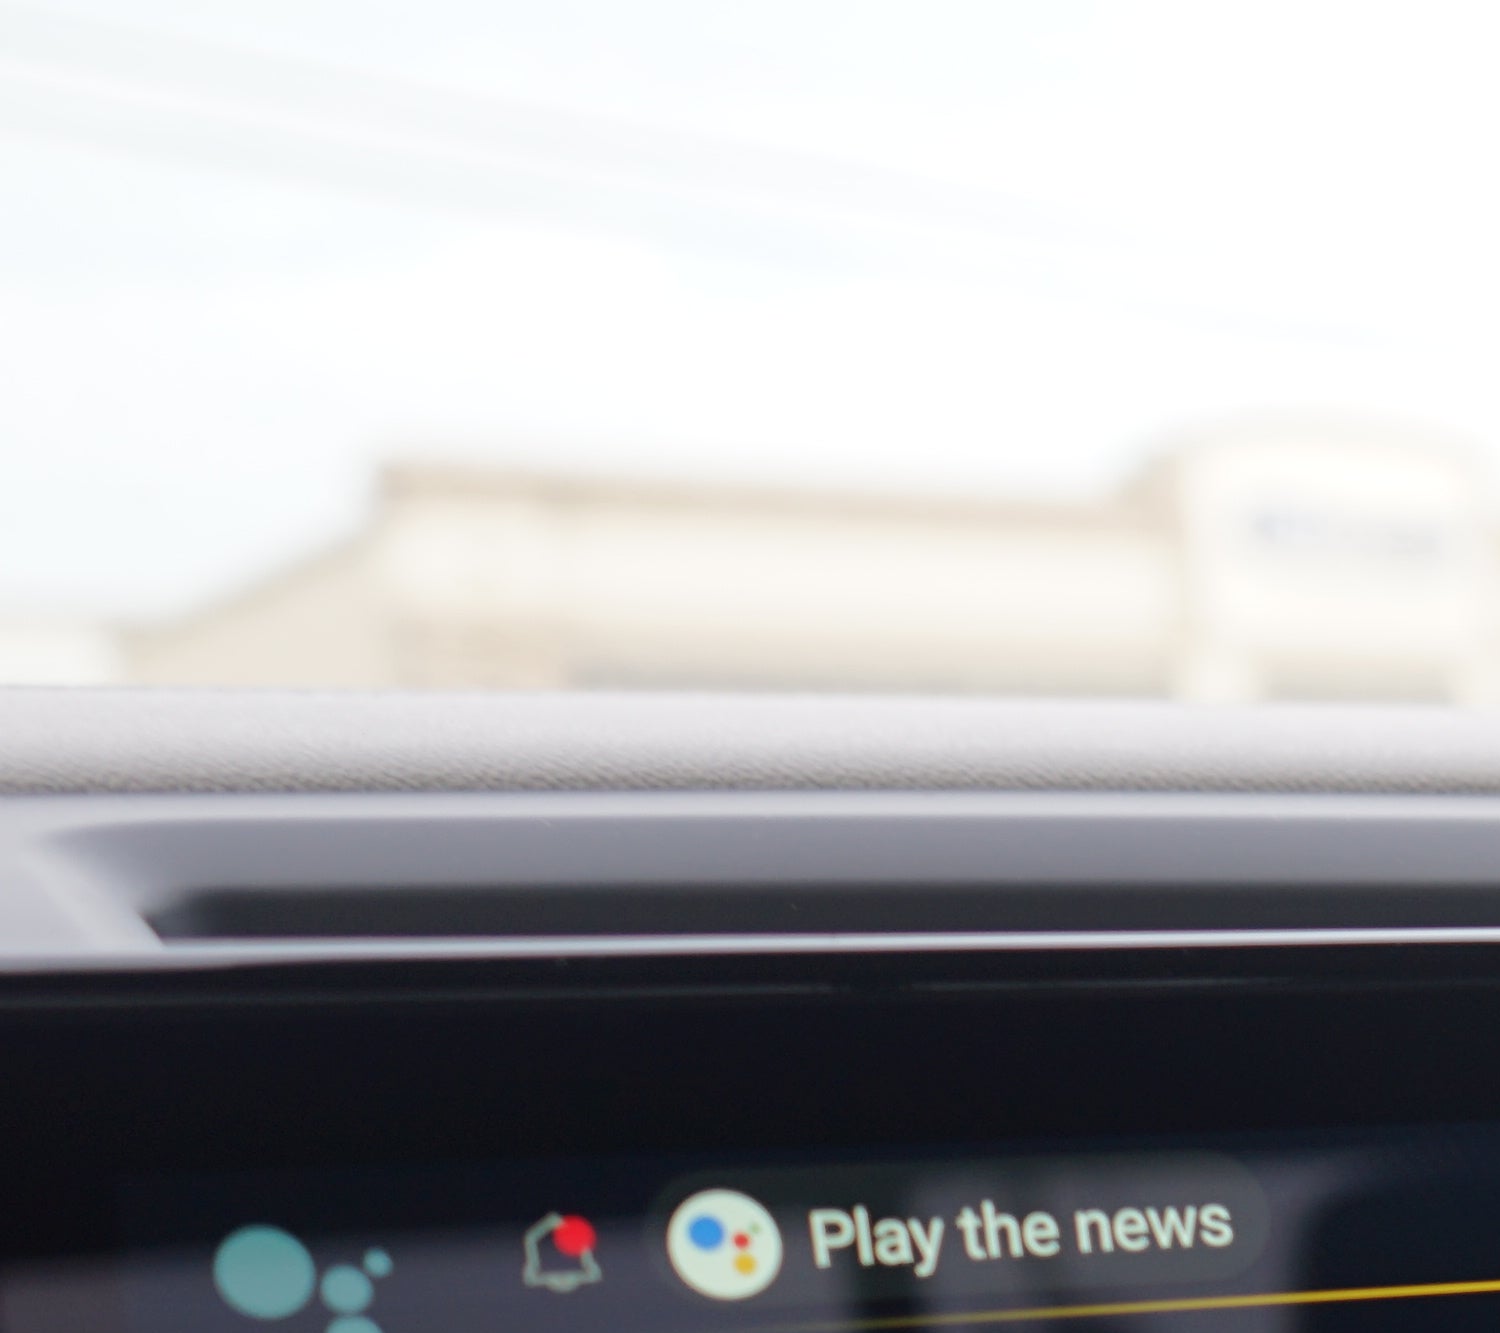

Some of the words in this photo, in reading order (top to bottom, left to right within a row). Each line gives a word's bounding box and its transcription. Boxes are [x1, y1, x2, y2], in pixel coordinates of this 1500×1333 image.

[809, 1203, 944, 1277] Play
[956, 1199, 1060, 1261] the
[1075, 1201, 1234, 1256] news
